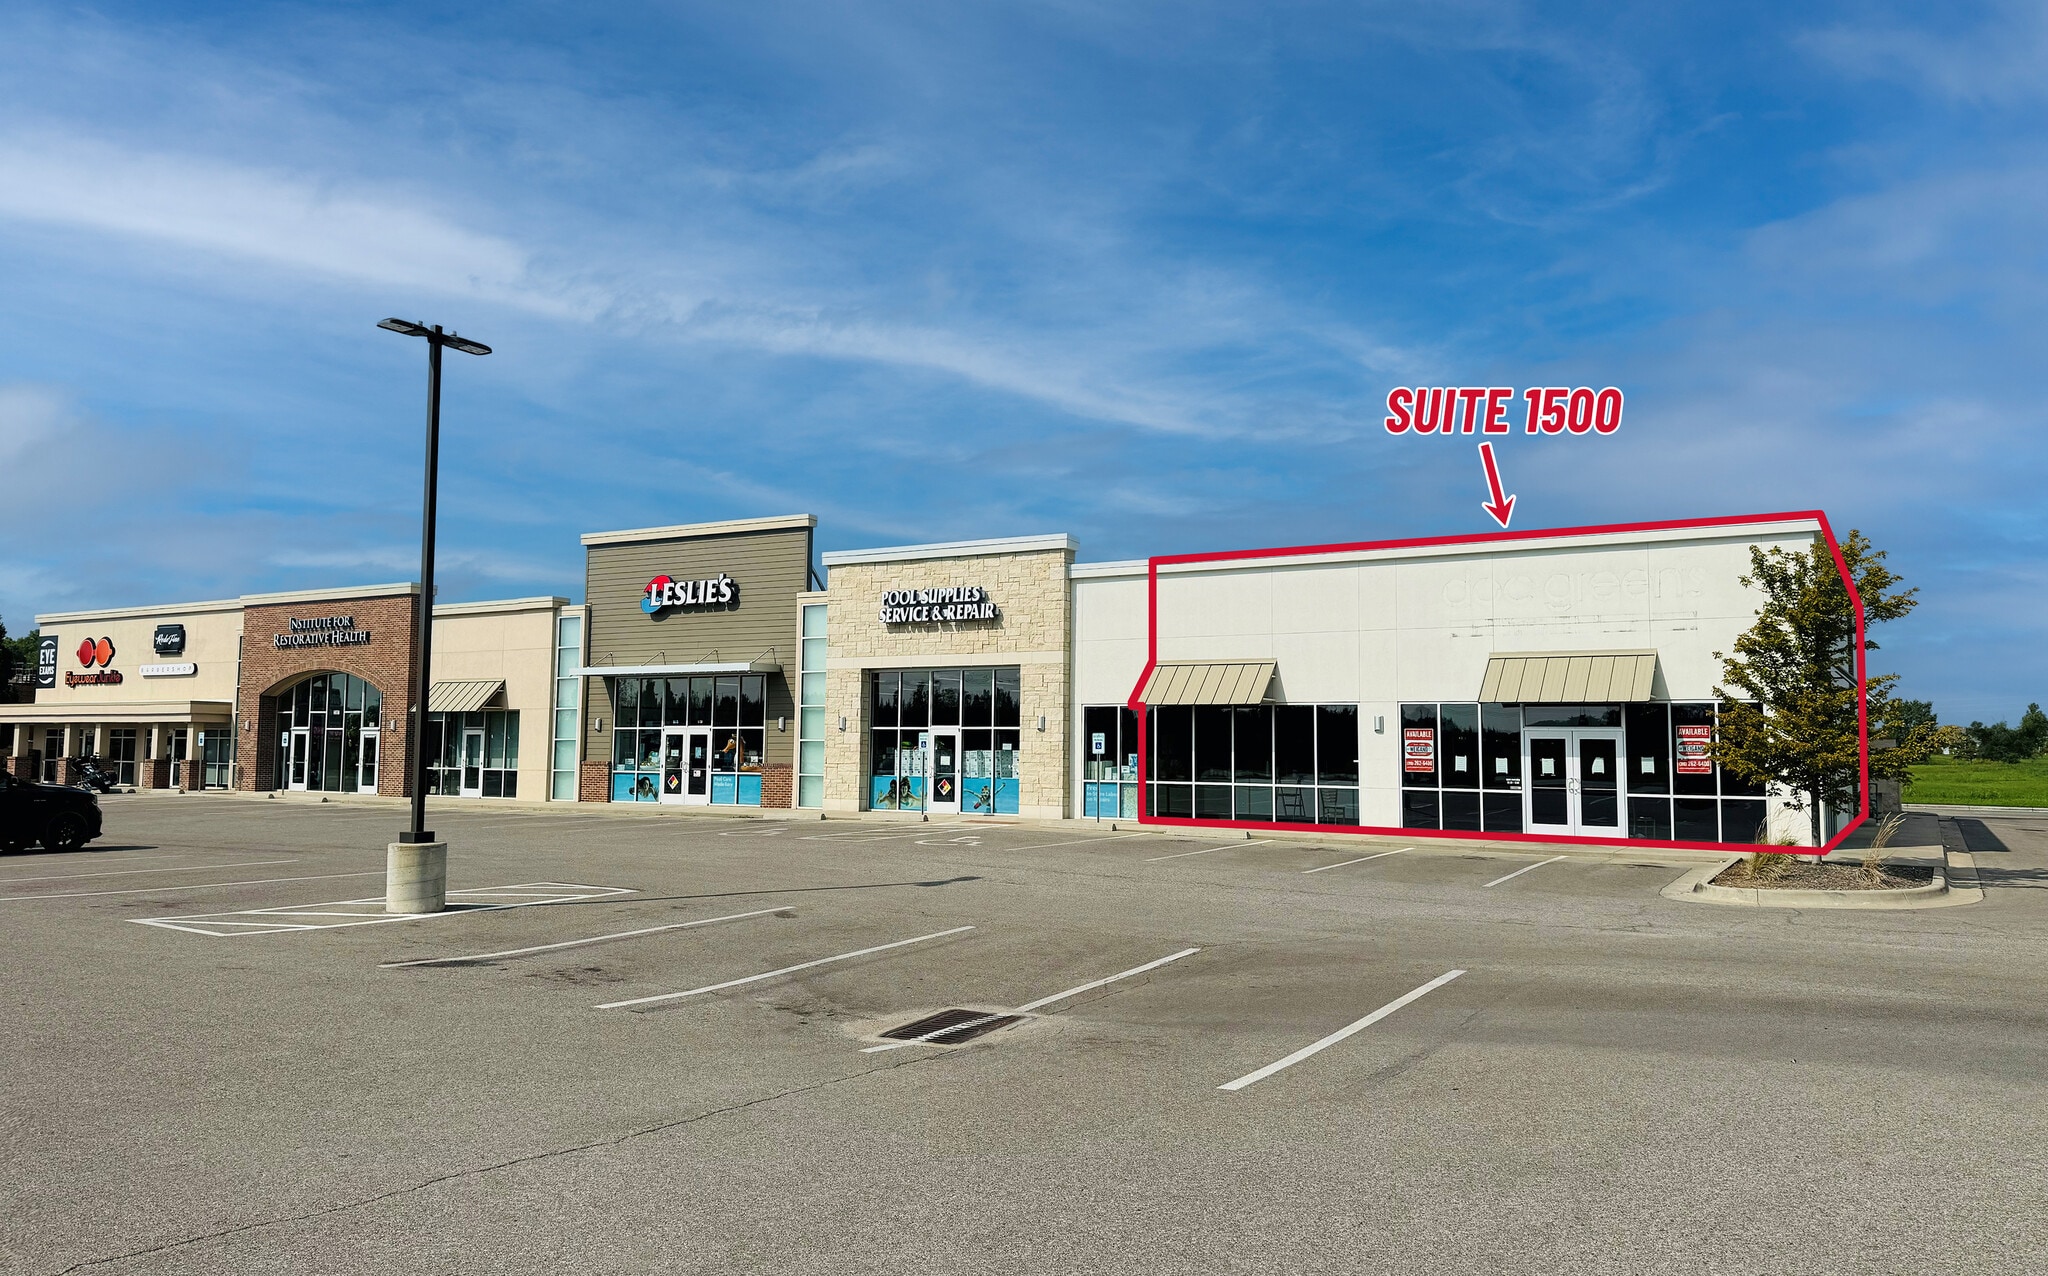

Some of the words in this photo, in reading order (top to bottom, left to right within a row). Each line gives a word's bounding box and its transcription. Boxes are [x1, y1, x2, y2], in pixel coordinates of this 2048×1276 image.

[650, 573, 732, 606] LESLIE'S
[881, 591, 917, 606] POOL
[920, 587, 980, 604] SUPPLIES
[879, 606, 929, 623] SERVICE
[932, 605, 943, 621] &
[947, 603, 994, 620] REPAIR
[289, 617, 332, 630] INSTITUTE
[333, 616, 351, 627] FOR
[273, 633, 330, 647] RESTORATIVE
[331, 630, 366, 643] HEALTH
[40, 648, 56, 665] EYE
[39, 666, 54, 675] EXAMS
